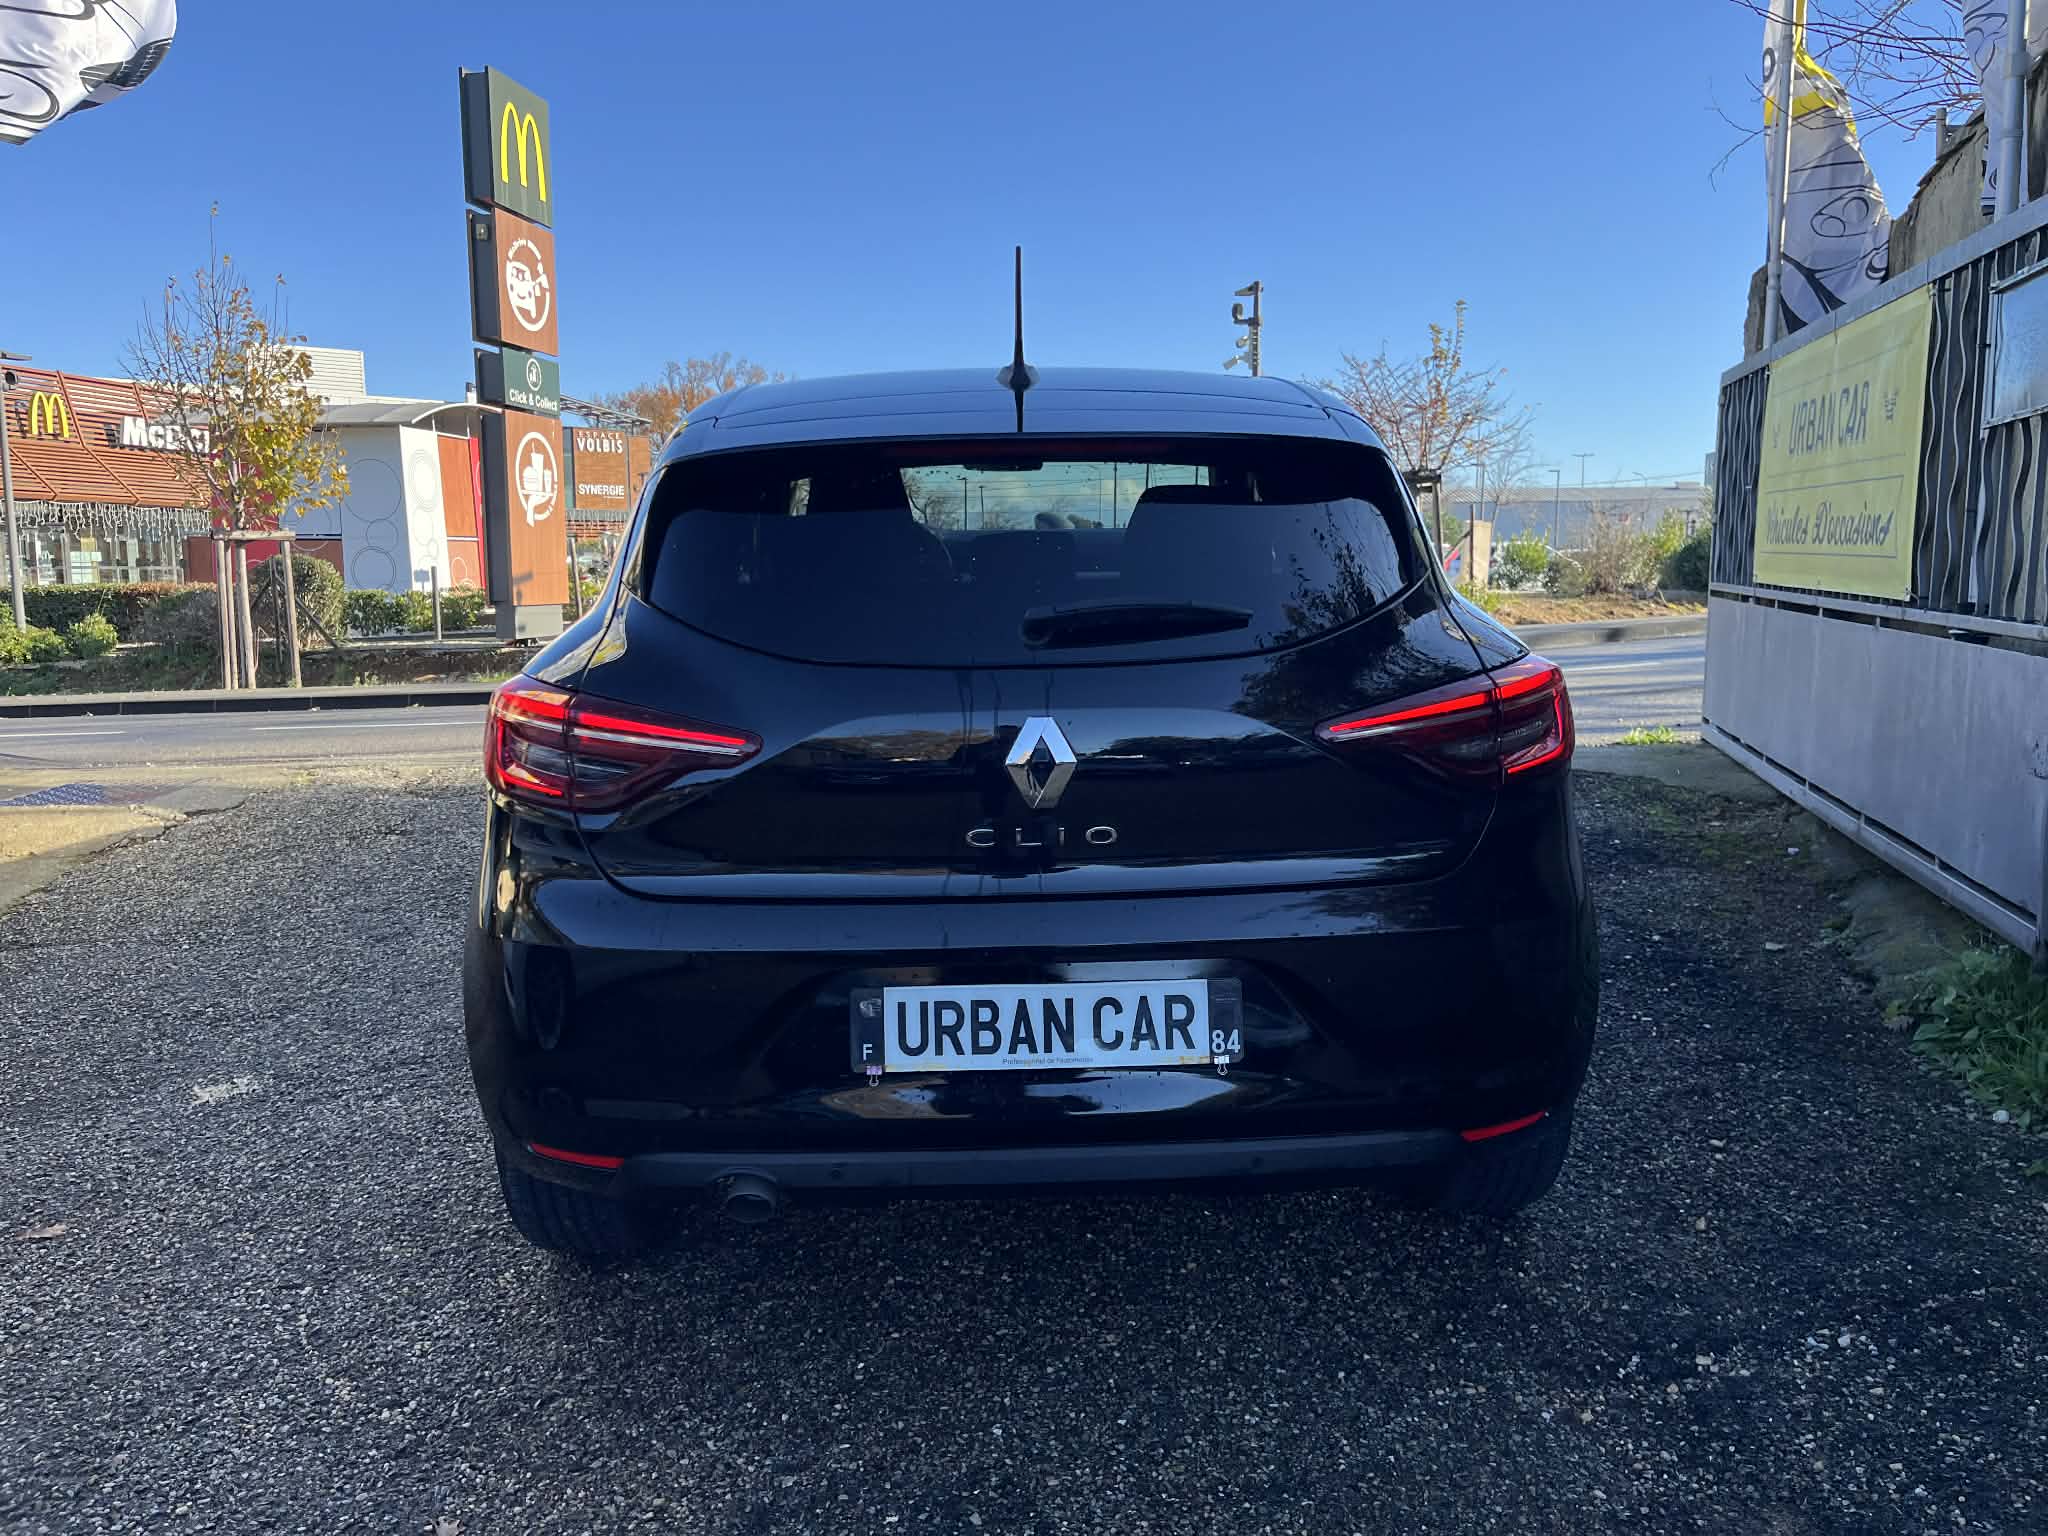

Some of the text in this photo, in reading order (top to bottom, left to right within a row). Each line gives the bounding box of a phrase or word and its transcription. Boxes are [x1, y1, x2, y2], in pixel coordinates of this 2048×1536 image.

[510, 389, 558, 411] Click & Collect
[1789, 381, 1869, 456] URBAN CAR
[577, 438, 623, 454] VOLBIS
[578, 431, 620, 440] ESPACE
[578, 483, 625, 496] SYNERGIE
[966, 826, 1118, 847] CLIO
[897, 994, 1196, 1057] URBAN CAR
[1211, 1028, 1241, 1054] 84
[863, 1043, 873, 1061] F
